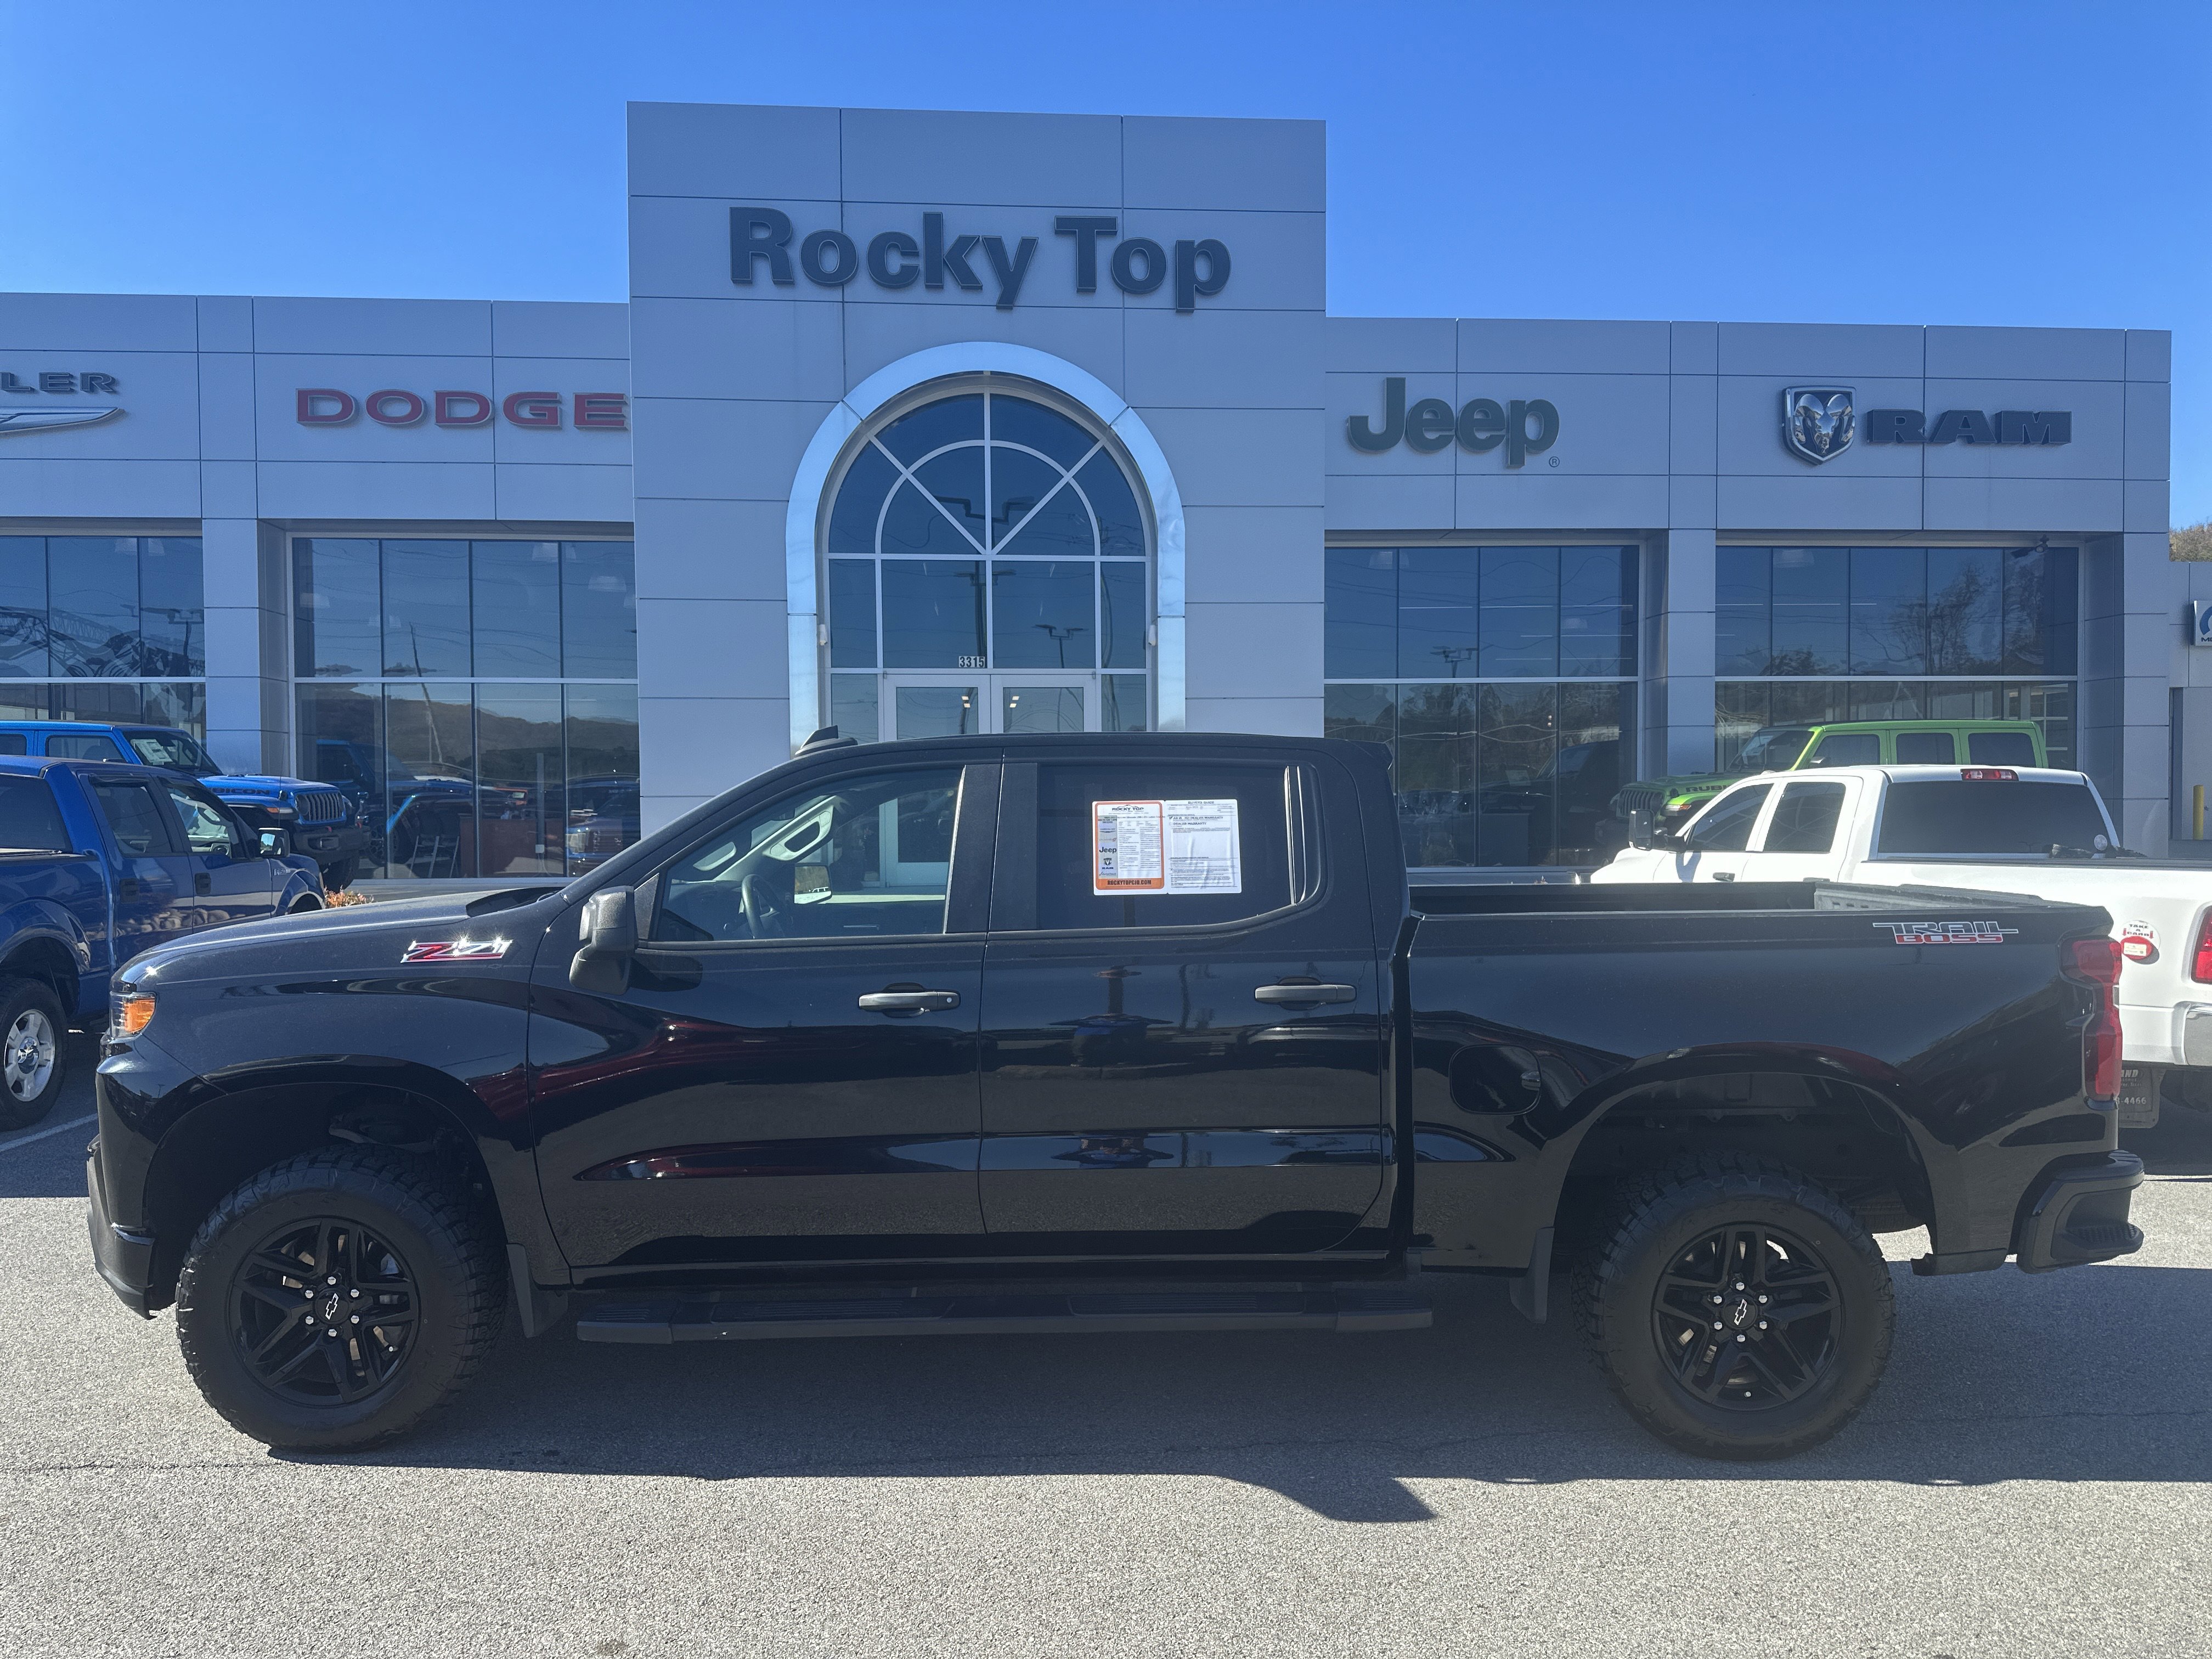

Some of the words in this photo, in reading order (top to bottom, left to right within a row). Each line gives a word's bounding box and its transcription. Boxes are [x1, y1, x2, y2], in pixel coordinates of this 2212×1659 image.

[729, 207, 1039, 309] Rocky
[1054, 216, 1232, 312] Top
[0, 371, 116, 393] LER
[296, 388, 630, 431] DODGE
[1346, 377, 1560, 469] Jeep
[1866, 409, 2072, 445] RAM
[960, 656, 984, 668] 3315
[208, 787, 270, 795] BICON
[1872, 921, 2019, 934] TRAIL
[1895, 933, 2004, 944] BOSS
[400, 939, 514, 963] Z71
